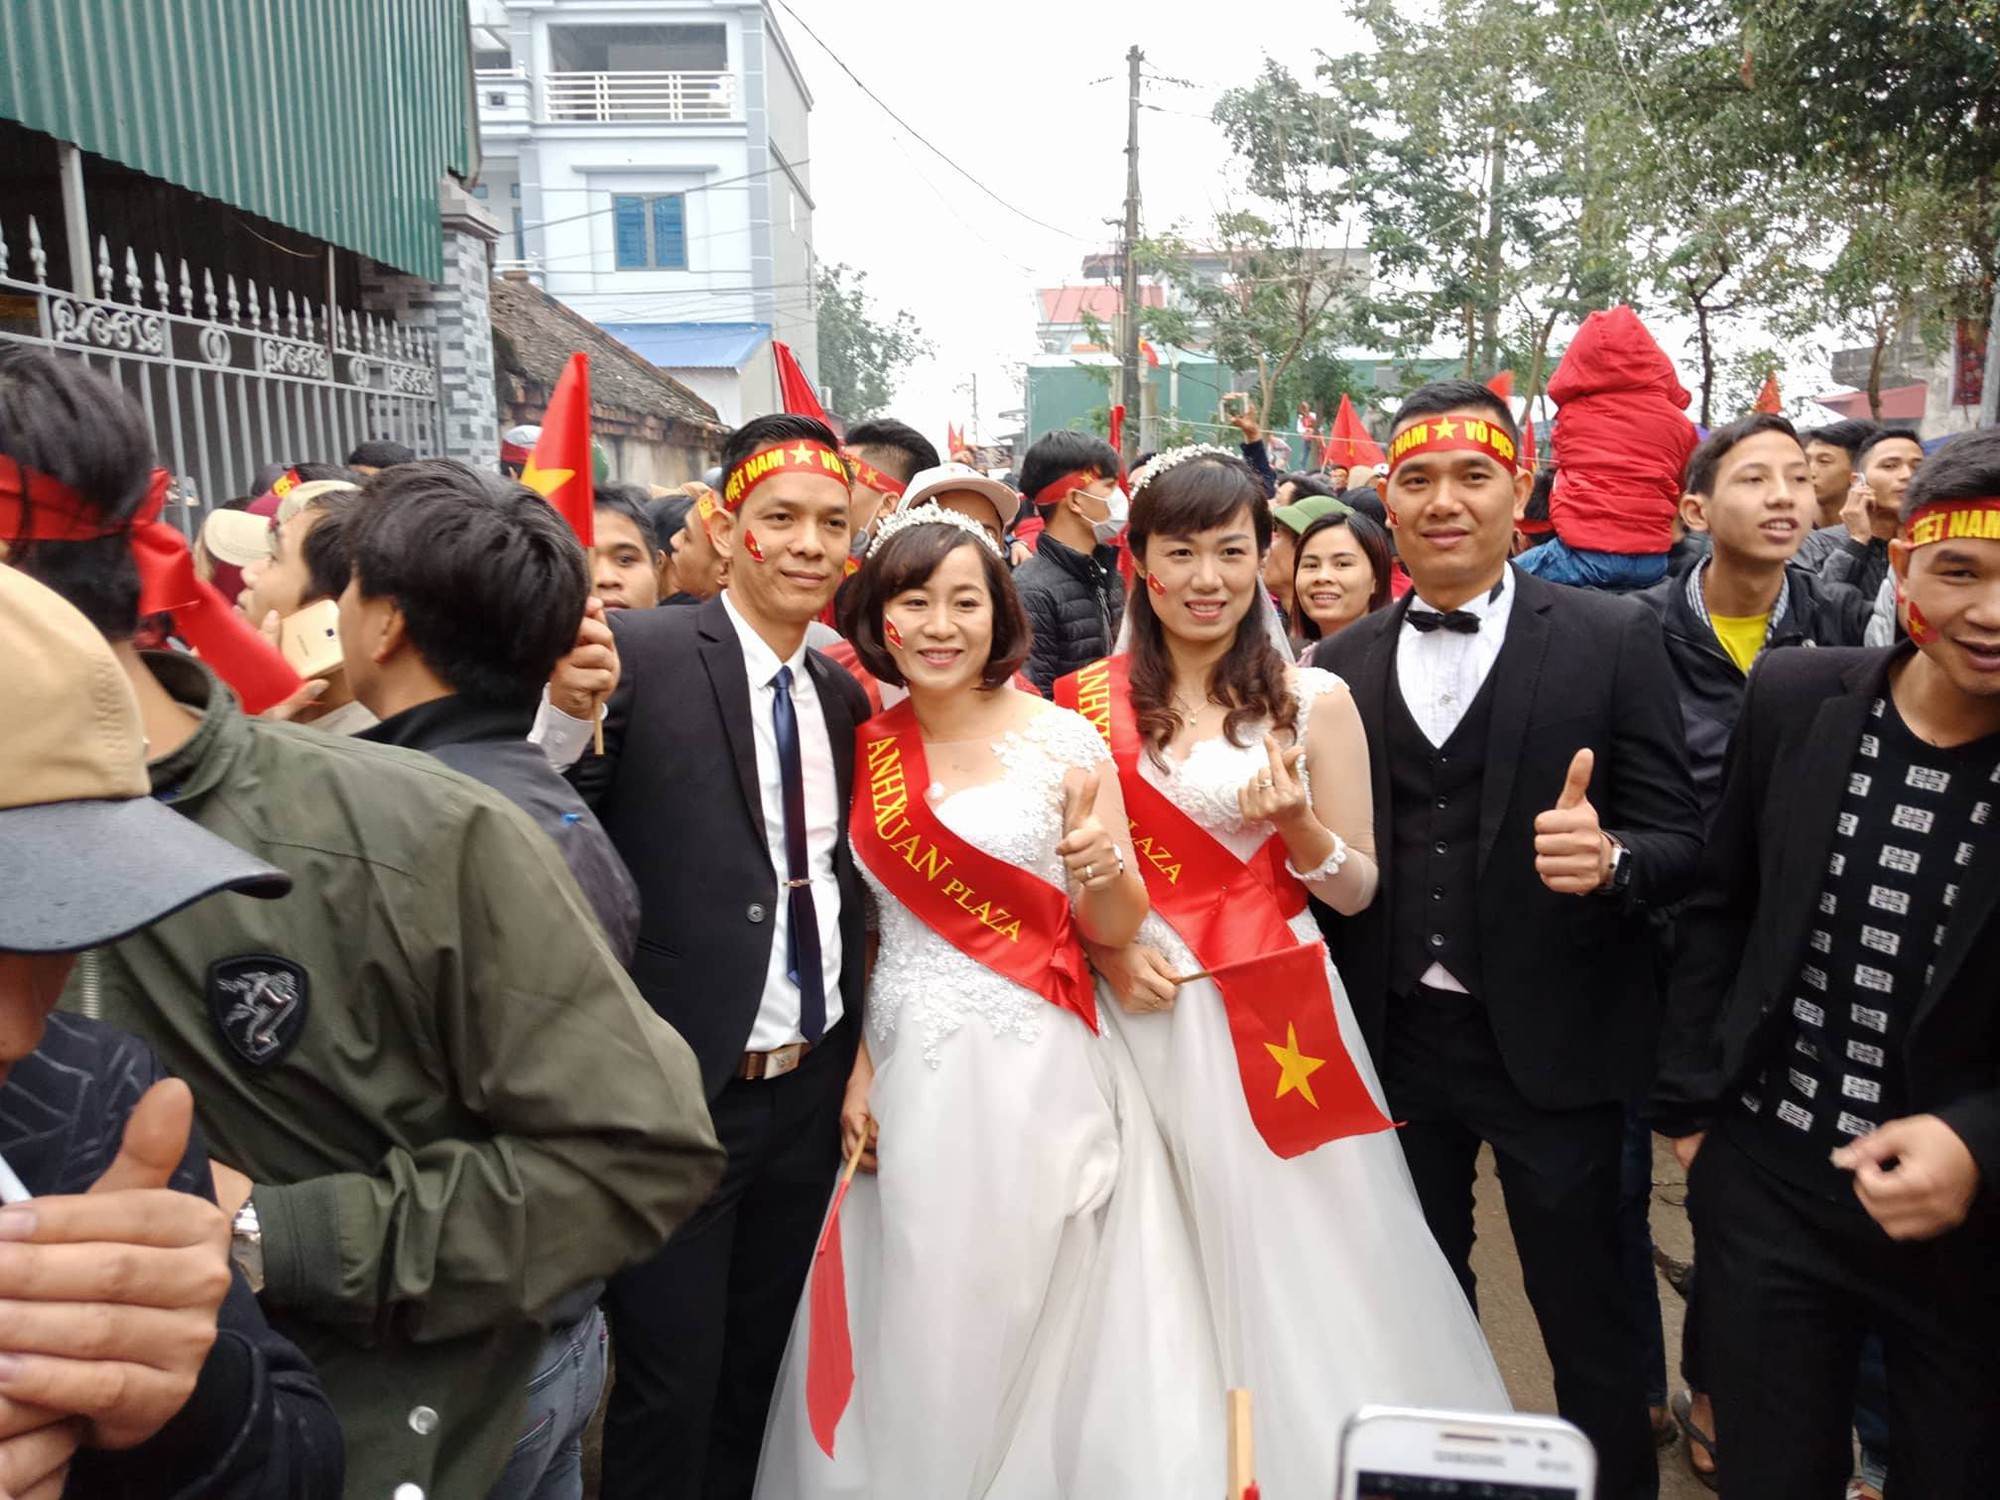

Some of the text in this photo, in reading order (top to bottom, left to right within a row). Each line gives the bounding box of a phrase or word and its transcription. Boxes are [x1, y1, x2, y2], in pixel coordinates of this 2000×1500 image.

[1395, 424, 1428, 457] NAM
[1464, 420, 1488, 443] VÔ
[745, 448, 785, 482] NAM
[867, 736, 1021, 944] ANHXUAN PLAZA
